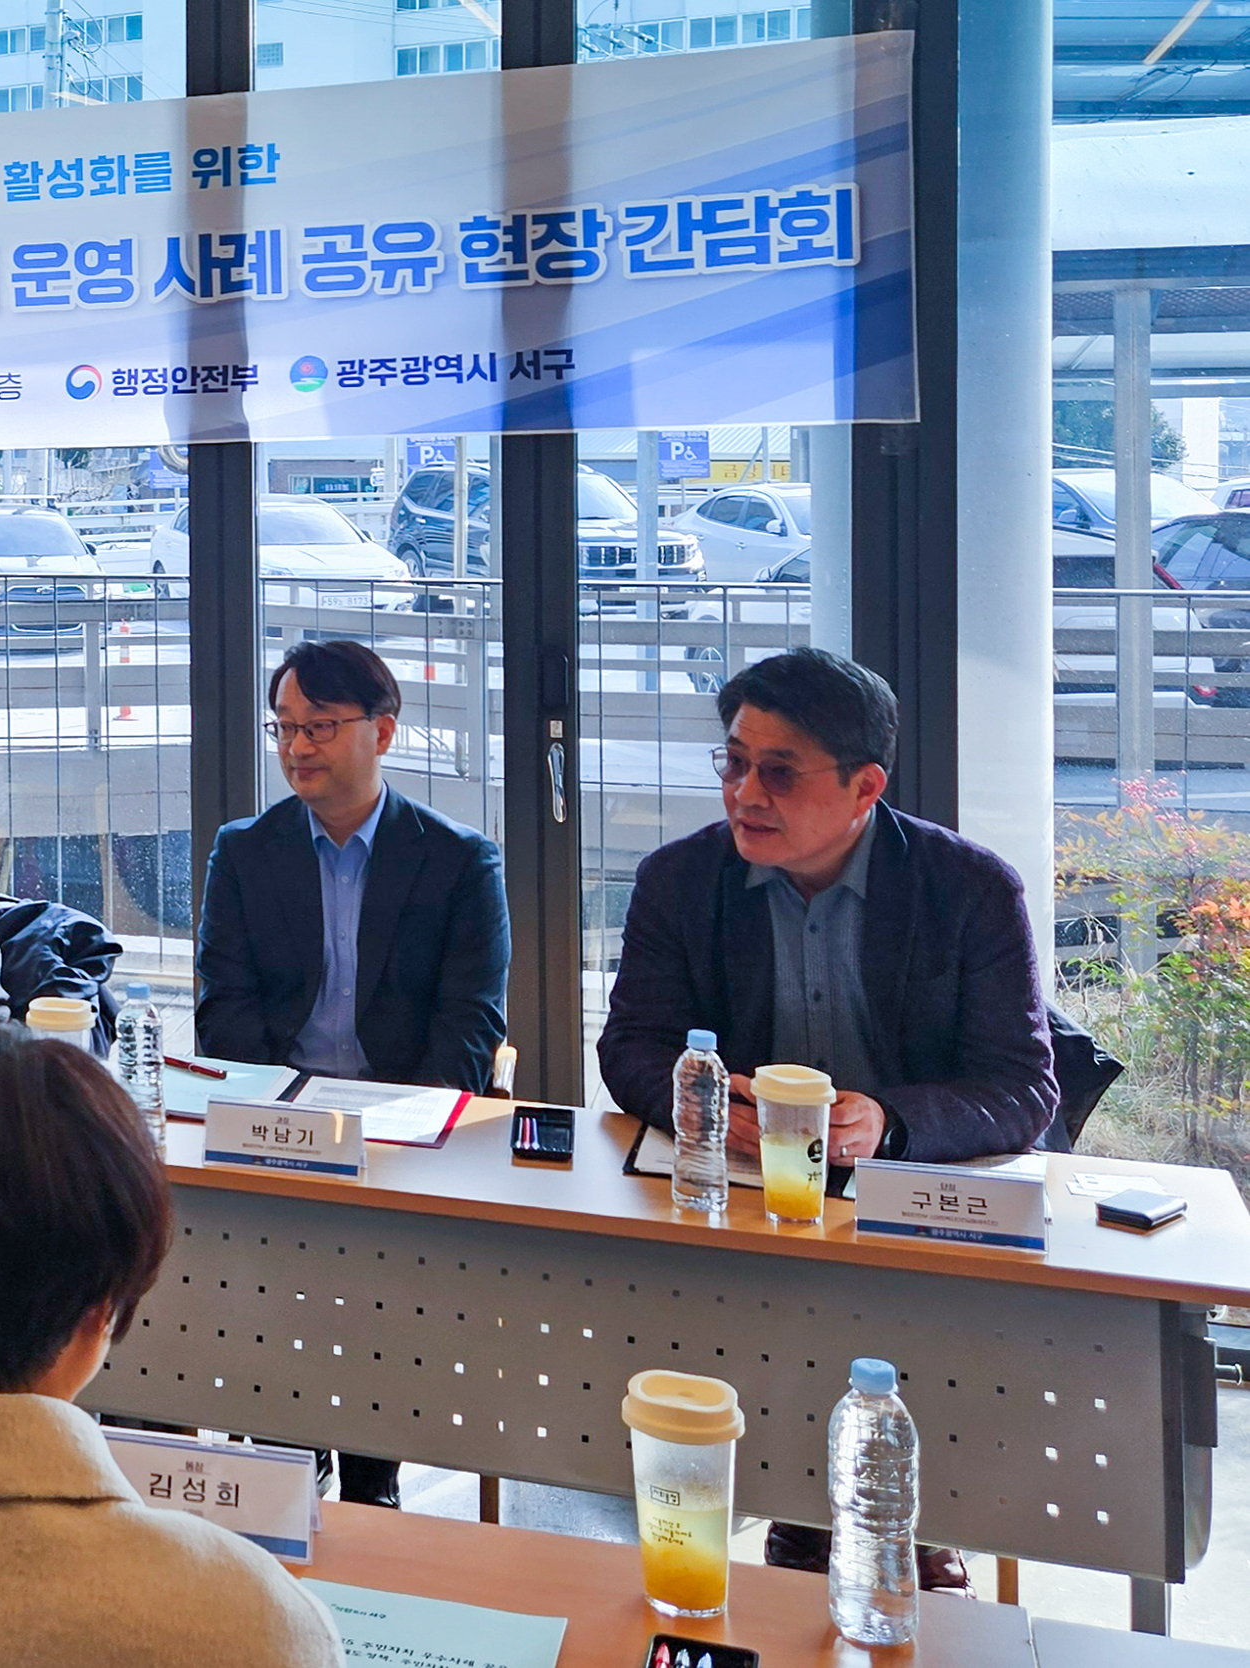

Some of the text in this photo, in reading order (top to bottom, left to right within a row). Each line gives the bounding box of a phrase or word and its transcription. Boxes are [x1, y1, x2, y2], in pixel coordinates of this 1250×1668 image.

[3, 151, 172, 202] 활성화를
[192, 143, 281, 189] 위한
[11, 238, 134, 308] 운영
[154, 229, 283, 299] 사례
[302, 220, 438, 293] 공유
[459, 207, 607, 284] 현장
[625, 188, 853, 274] 간담회
[111, 364, 259, 396] 행정안전부
[336, 349, 576, 389] 광주광역시 서구
[671, 441, 685, 461] P
[252, 1125, 314, 1146] 박남기
[911, 1191, 988, 1215] 구본근
[149, 1473, 240, 1507] 김성희
[362, 1641, 414, 1657] 주민자치
